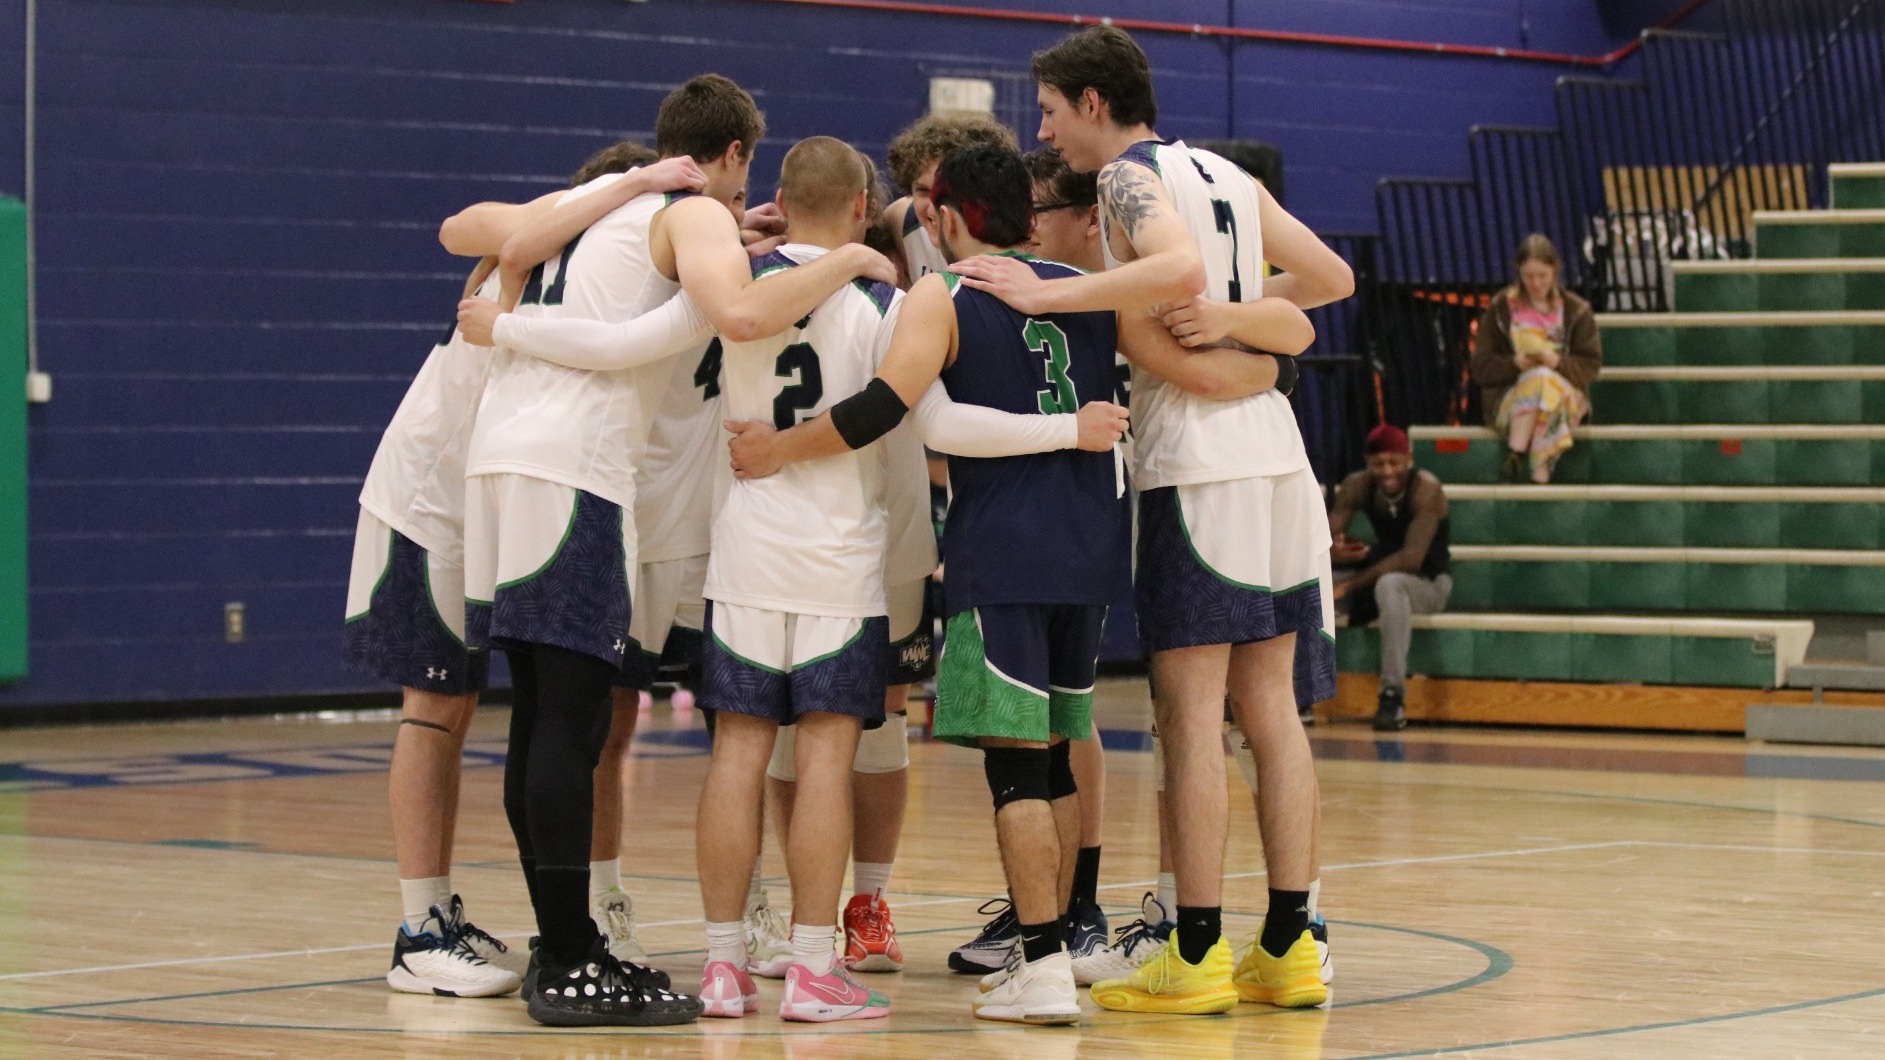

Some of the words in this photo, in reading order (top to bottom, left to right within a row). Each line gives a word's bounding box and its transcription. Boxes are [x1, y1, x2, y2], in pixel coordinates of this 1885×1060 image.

[1210, 198, 1242, 303] 7
[693, 336, 724, 402] 4
[772, 341, 824, 431] 2
[1022, 317, 1079, 416] 3
